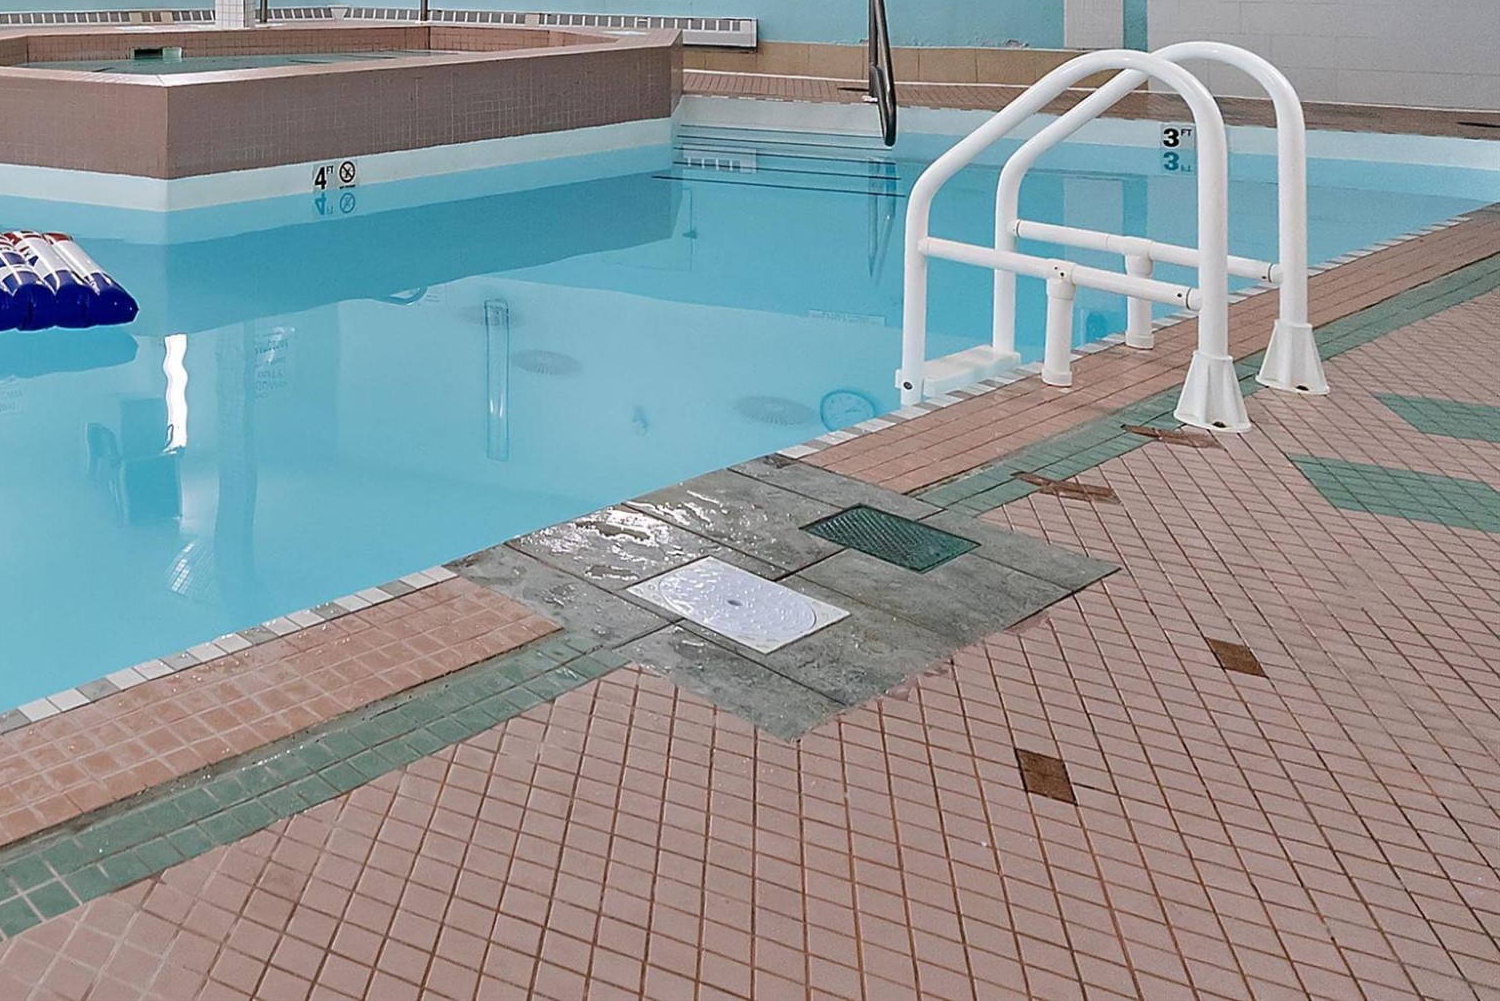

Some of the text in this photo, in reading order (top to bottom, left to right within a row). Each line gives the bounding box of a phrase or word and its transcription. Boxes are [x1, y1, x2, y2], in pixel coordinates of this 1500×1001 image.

[1163, 128, 1193, 148] 3 FT
[314, 165, 335, 190] 4 FT
